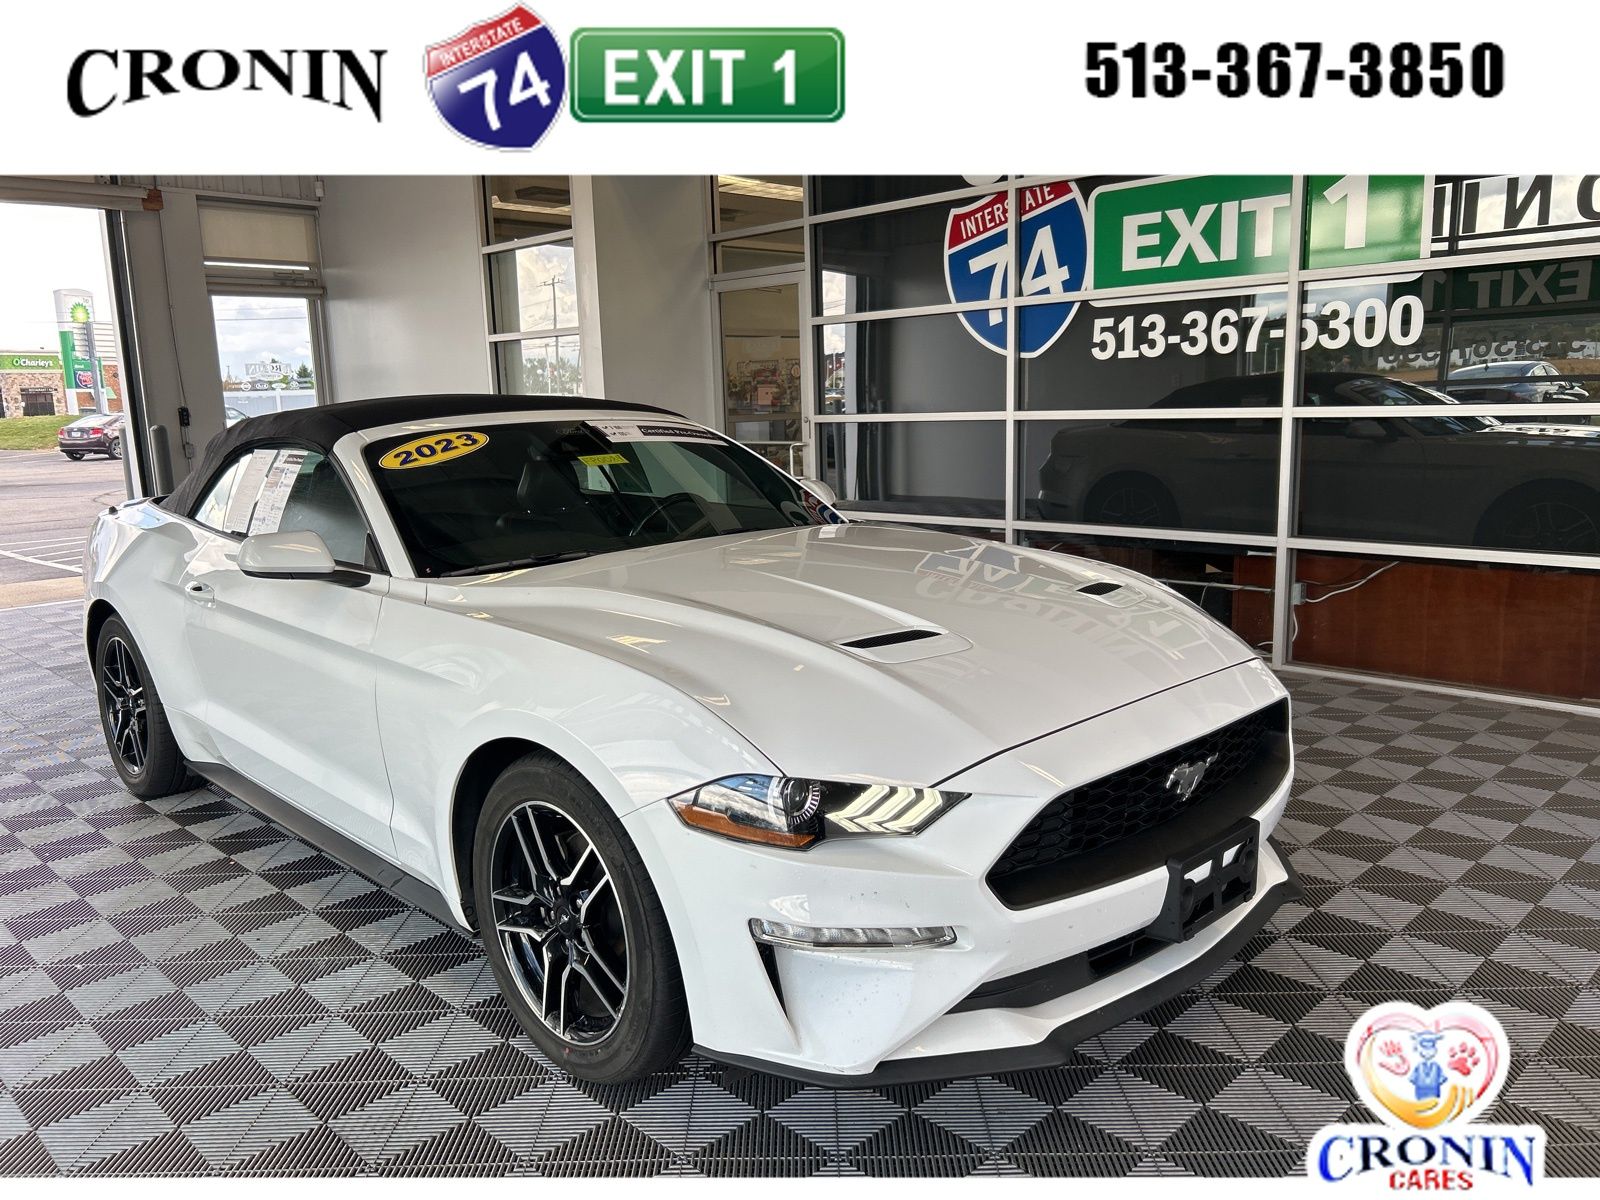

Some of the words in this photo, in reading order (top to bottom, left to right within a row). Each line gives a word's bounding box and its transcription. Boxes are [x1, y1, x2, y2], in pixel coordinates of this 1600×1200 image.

[1121, 194, 1292, 272] EXIT
[1322, 174, 1369, 250] 1
[968, 224, 1070, 326] 74
[1091, 295, 1425, 363] 513-367-5300
[393, 433, 479, 467] 2023
